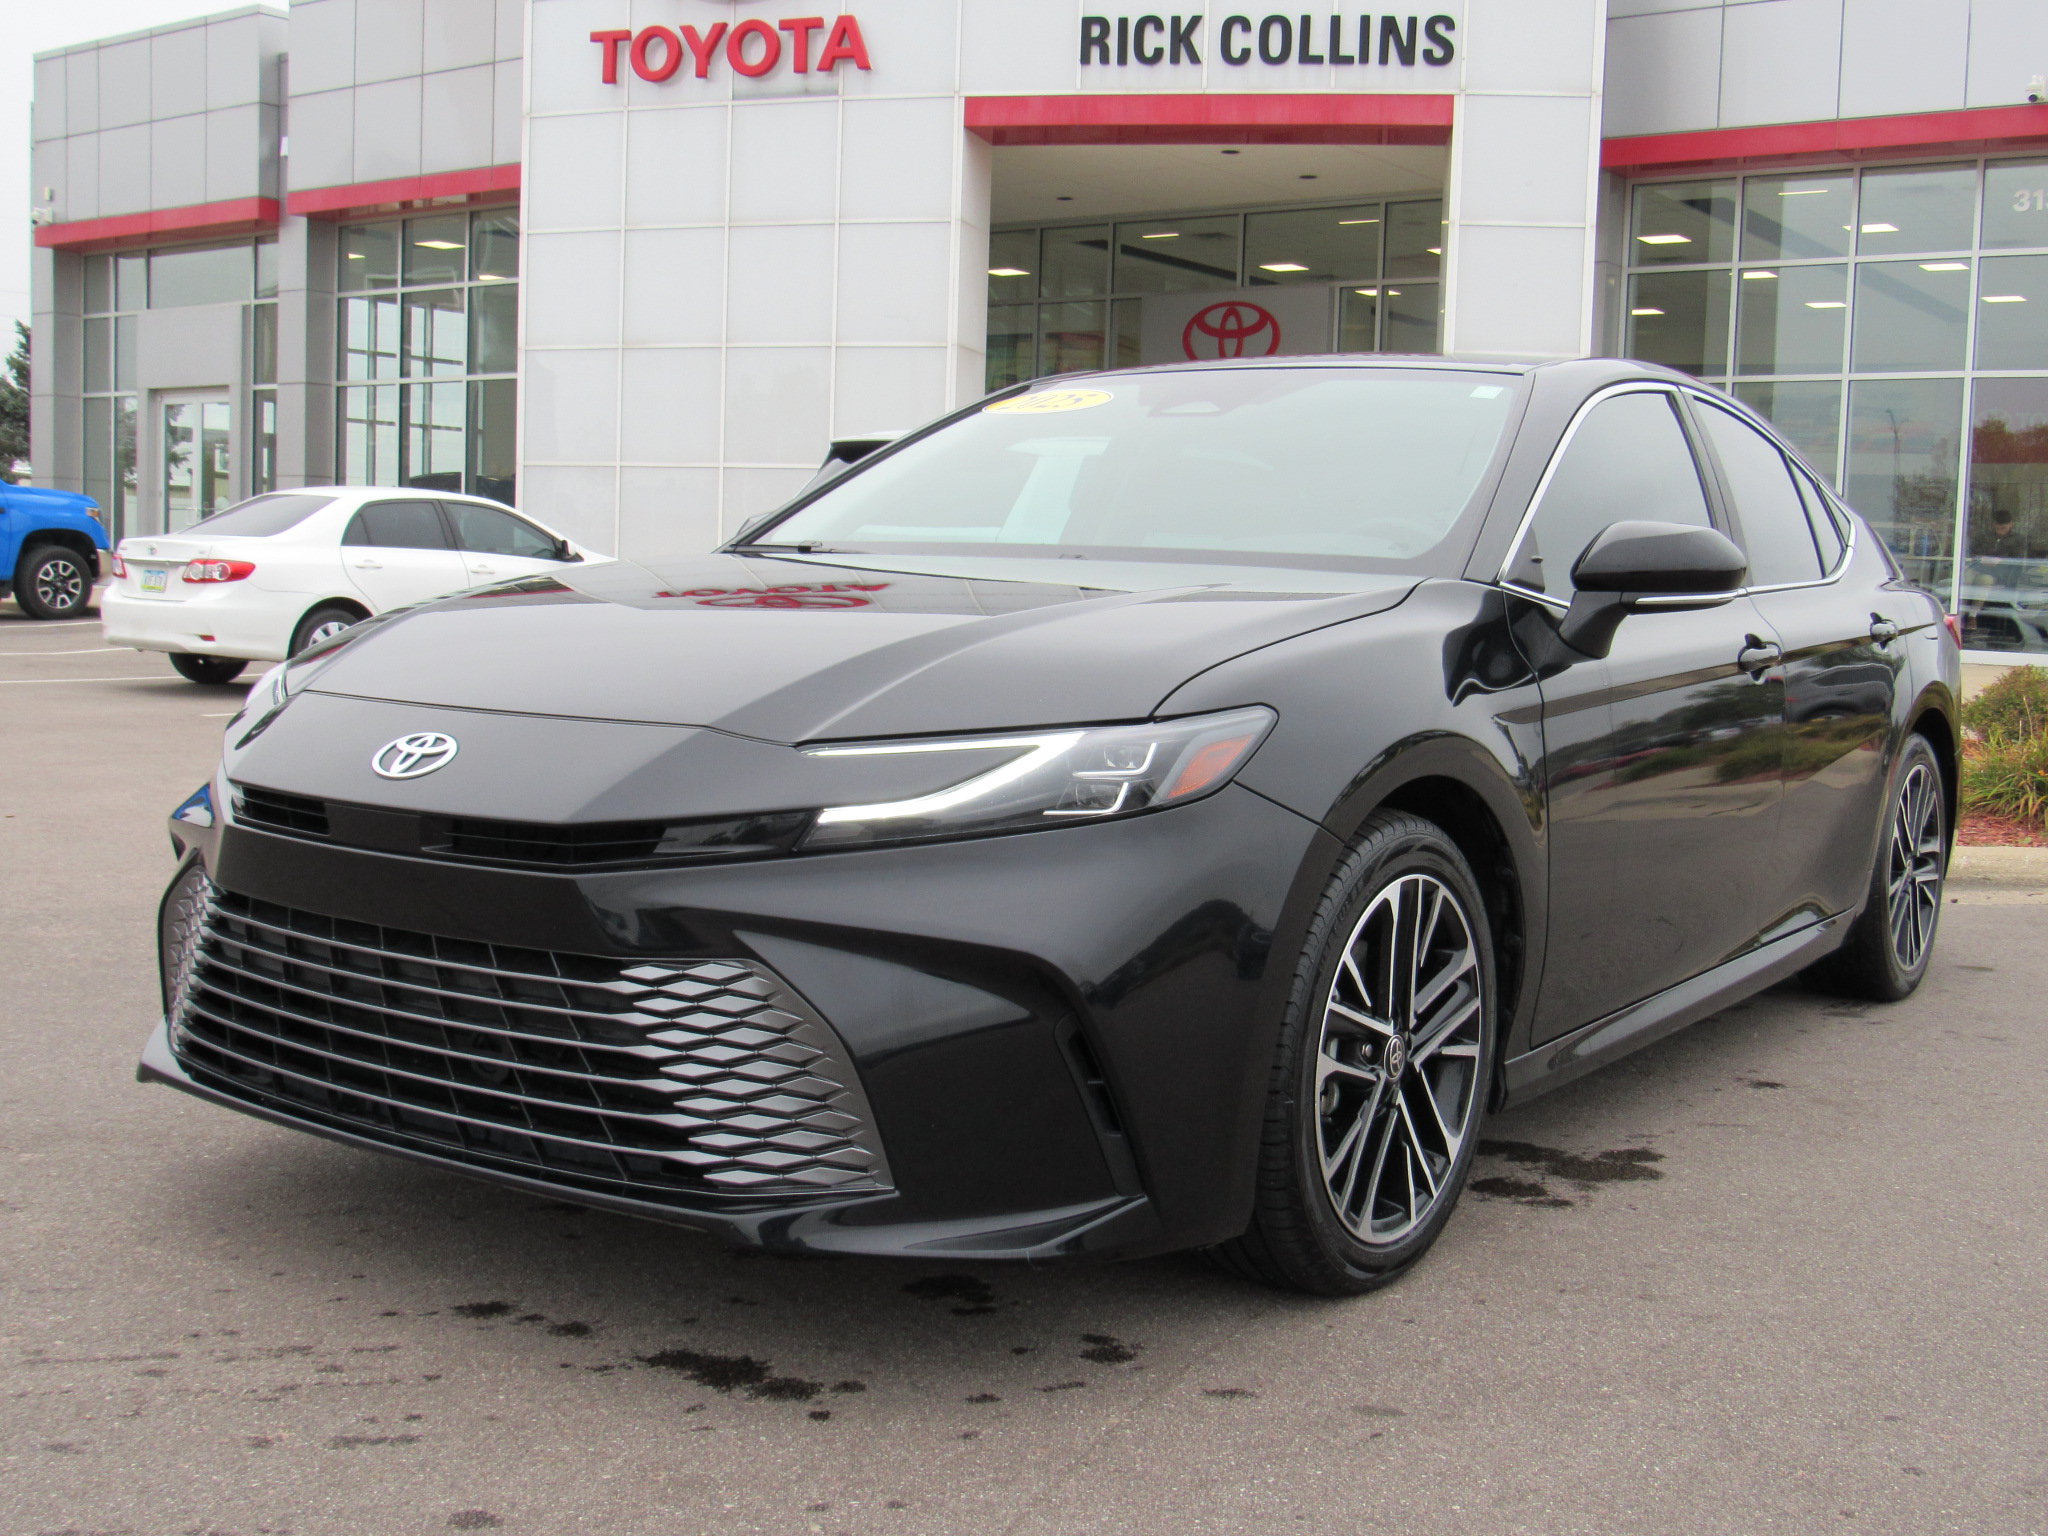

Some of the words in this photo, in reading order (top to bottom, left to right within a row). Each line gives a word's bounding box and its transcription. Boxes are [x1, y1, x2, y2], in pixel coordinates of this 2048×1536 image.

[590, 14, 872, 84] TOYOTA
[1080, 14, 1202, 66] RICK
[1220, 14, 1456, 66] COLLINS
[2012, 188, 2048, 212] 31
